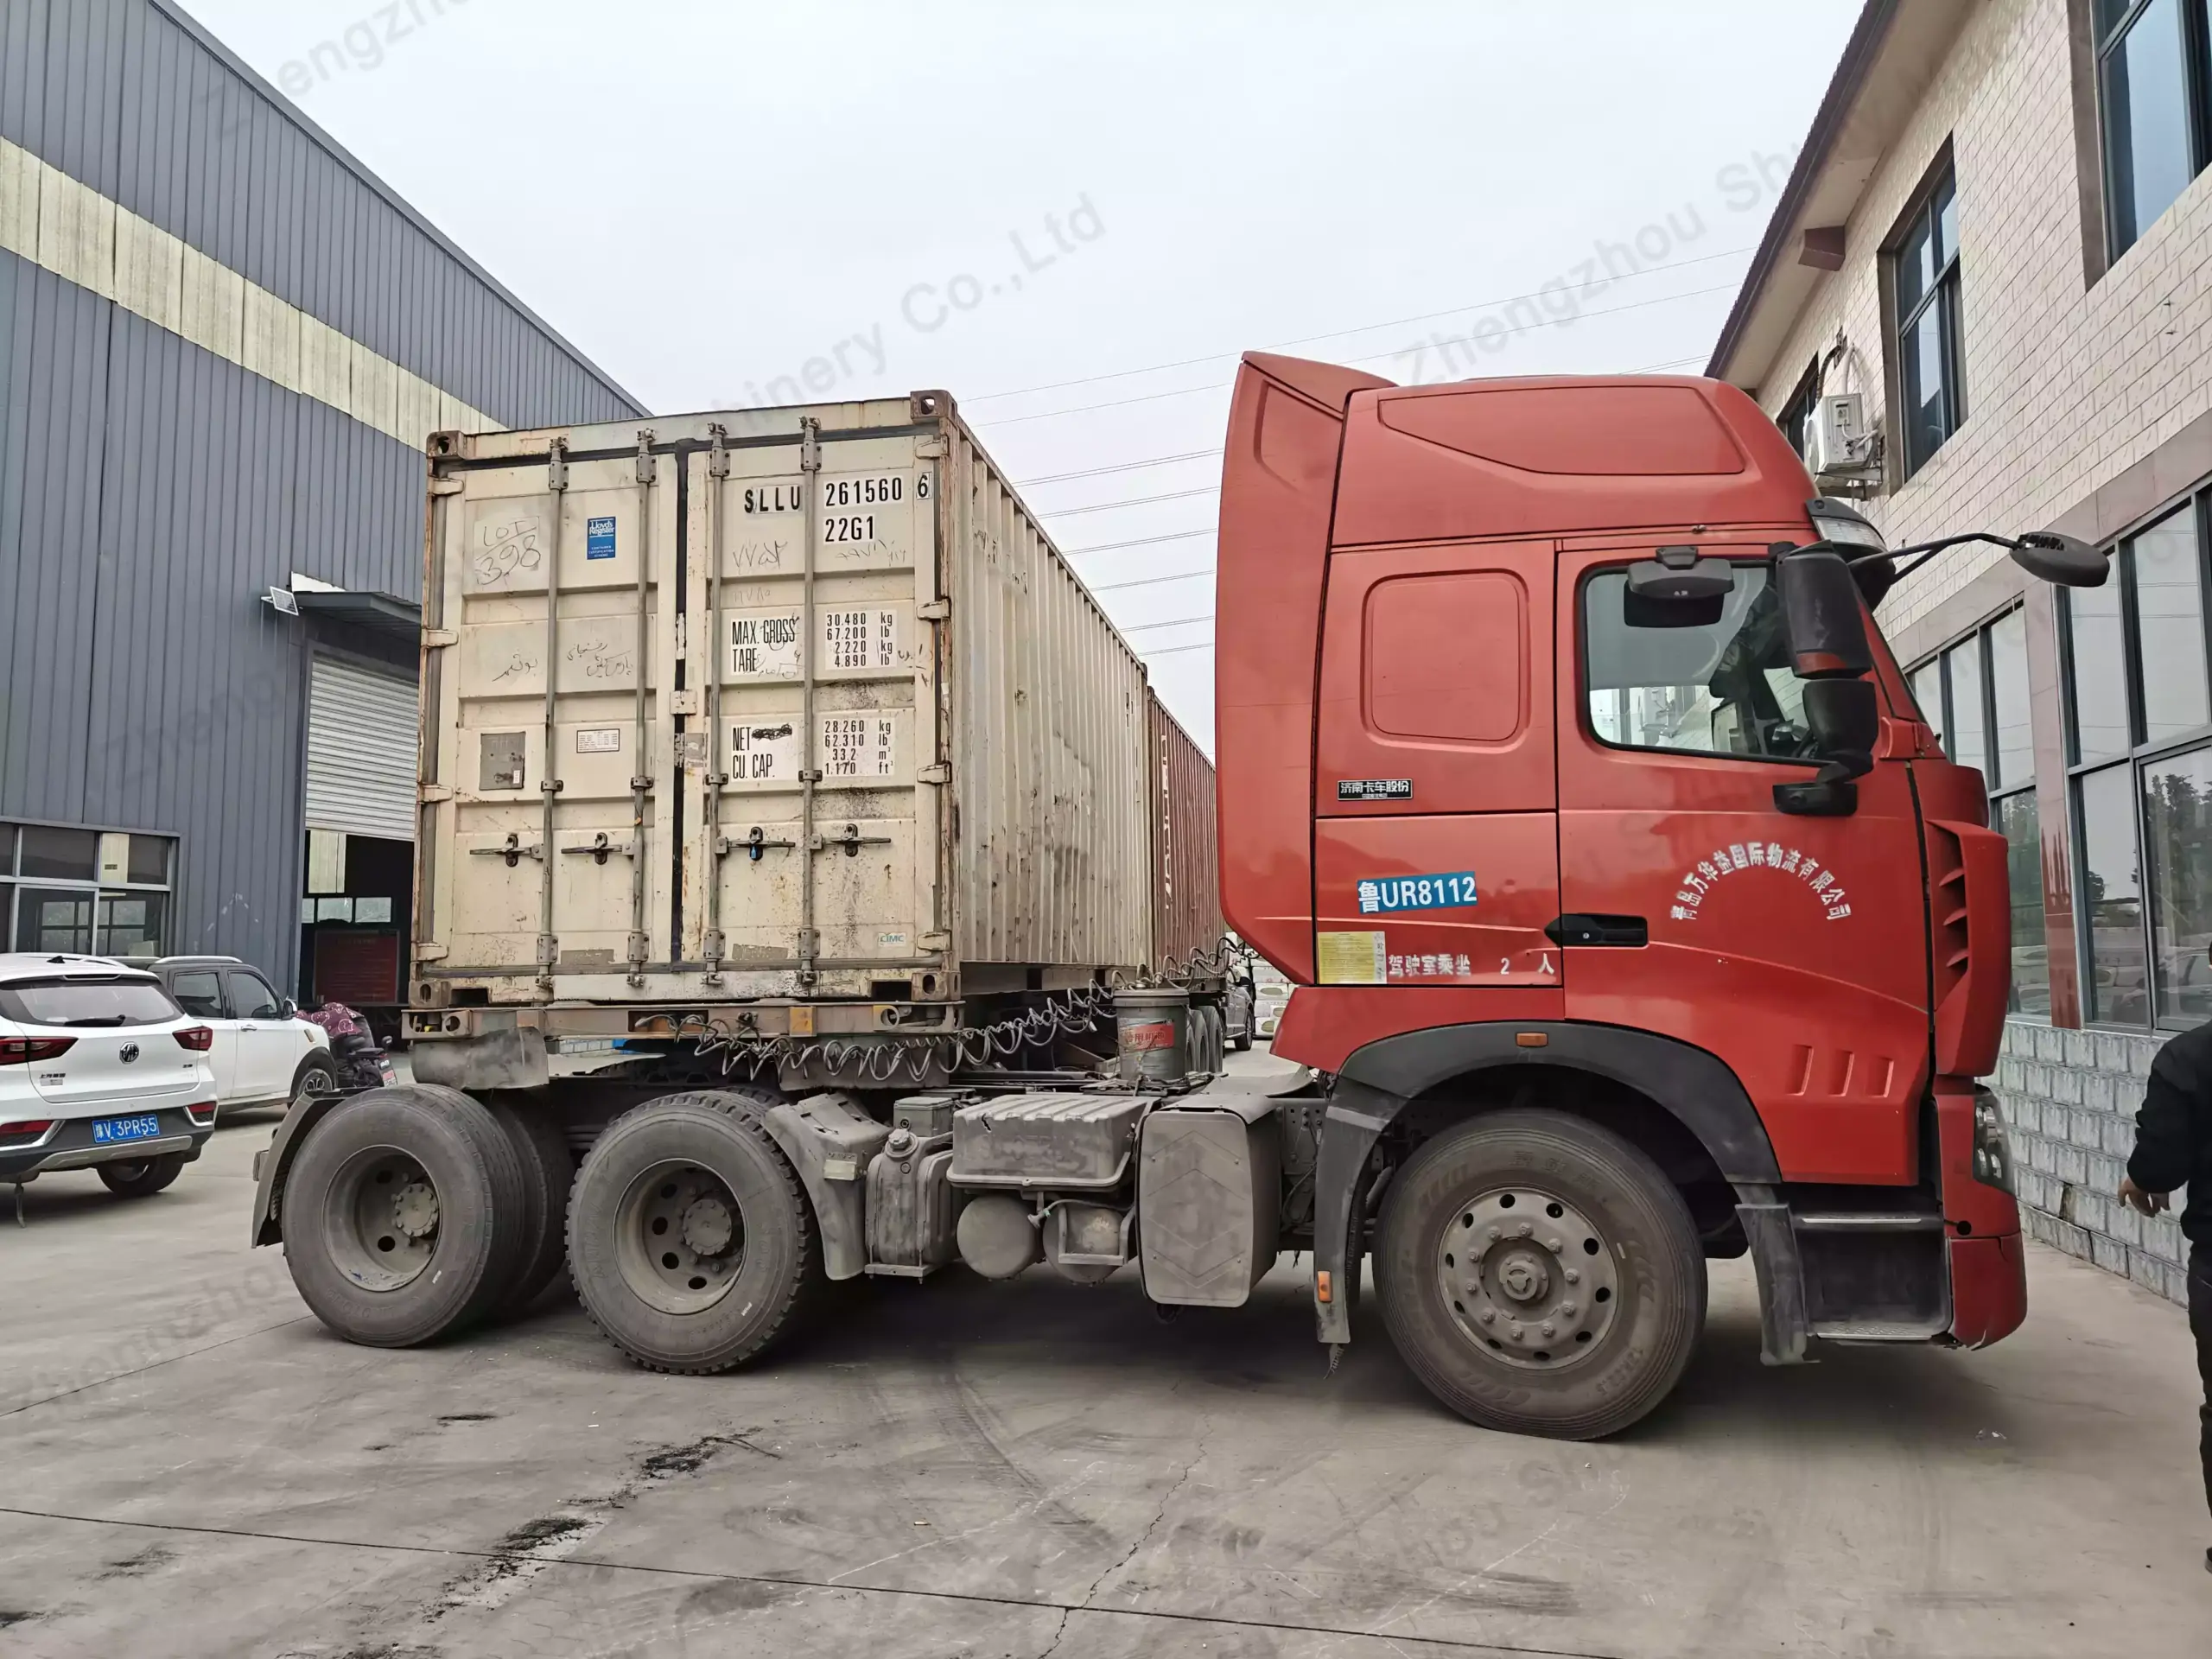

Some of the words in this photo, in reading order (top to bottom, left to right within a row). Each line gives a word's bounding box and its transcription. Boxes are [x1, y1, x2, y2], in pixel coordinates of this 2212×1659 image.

[744, 486, 801, 514] SLLU
[825, 477, 903, 507] 261560
[917, 474, 929, 499] 6
[825, 516, 874, 543] 22G1
[827, 612, 867, 626] 30.480
[880, 612, 893, 626] kg
[732, 620, 760, 645] MAX.
[763, 618, 796, 644] GROSS
[827, 626, 867, 640] 67.200
[880, 625, 890, 639] lb
[835, 640, 867, 654] 2.220
[880, 640, 893, 654] kg
[733, 648, 758, 672] TARE
[834, 653, 867, 668] 4.890
[880, 652, 890, 665] lb
[824, 720, 865, 734] 28.260
[879, 720, 892, 734] kg
[732, 727, 752, 751] NET
[824, 734, 865, 748] 62.310
[878, 734, 888, 746] lb
[832, 748, 856, 761] 33.2
[732, 754, 748, 779] CU.
[752, 753, 776, 779] CAP.
[824, 761, 856, 775] 1.170
[1340, 780, 1410, 794] 济南卡车股份
[1357, 876, 1478, 913] 鲁UR8112
[880, 934, 905, 944] CIMC
[1388, 953, 1471, 978] 驾驶室乘坐
[1500, 957, 1510, 976] 2
[1537, 952, 1555, 975] 人
